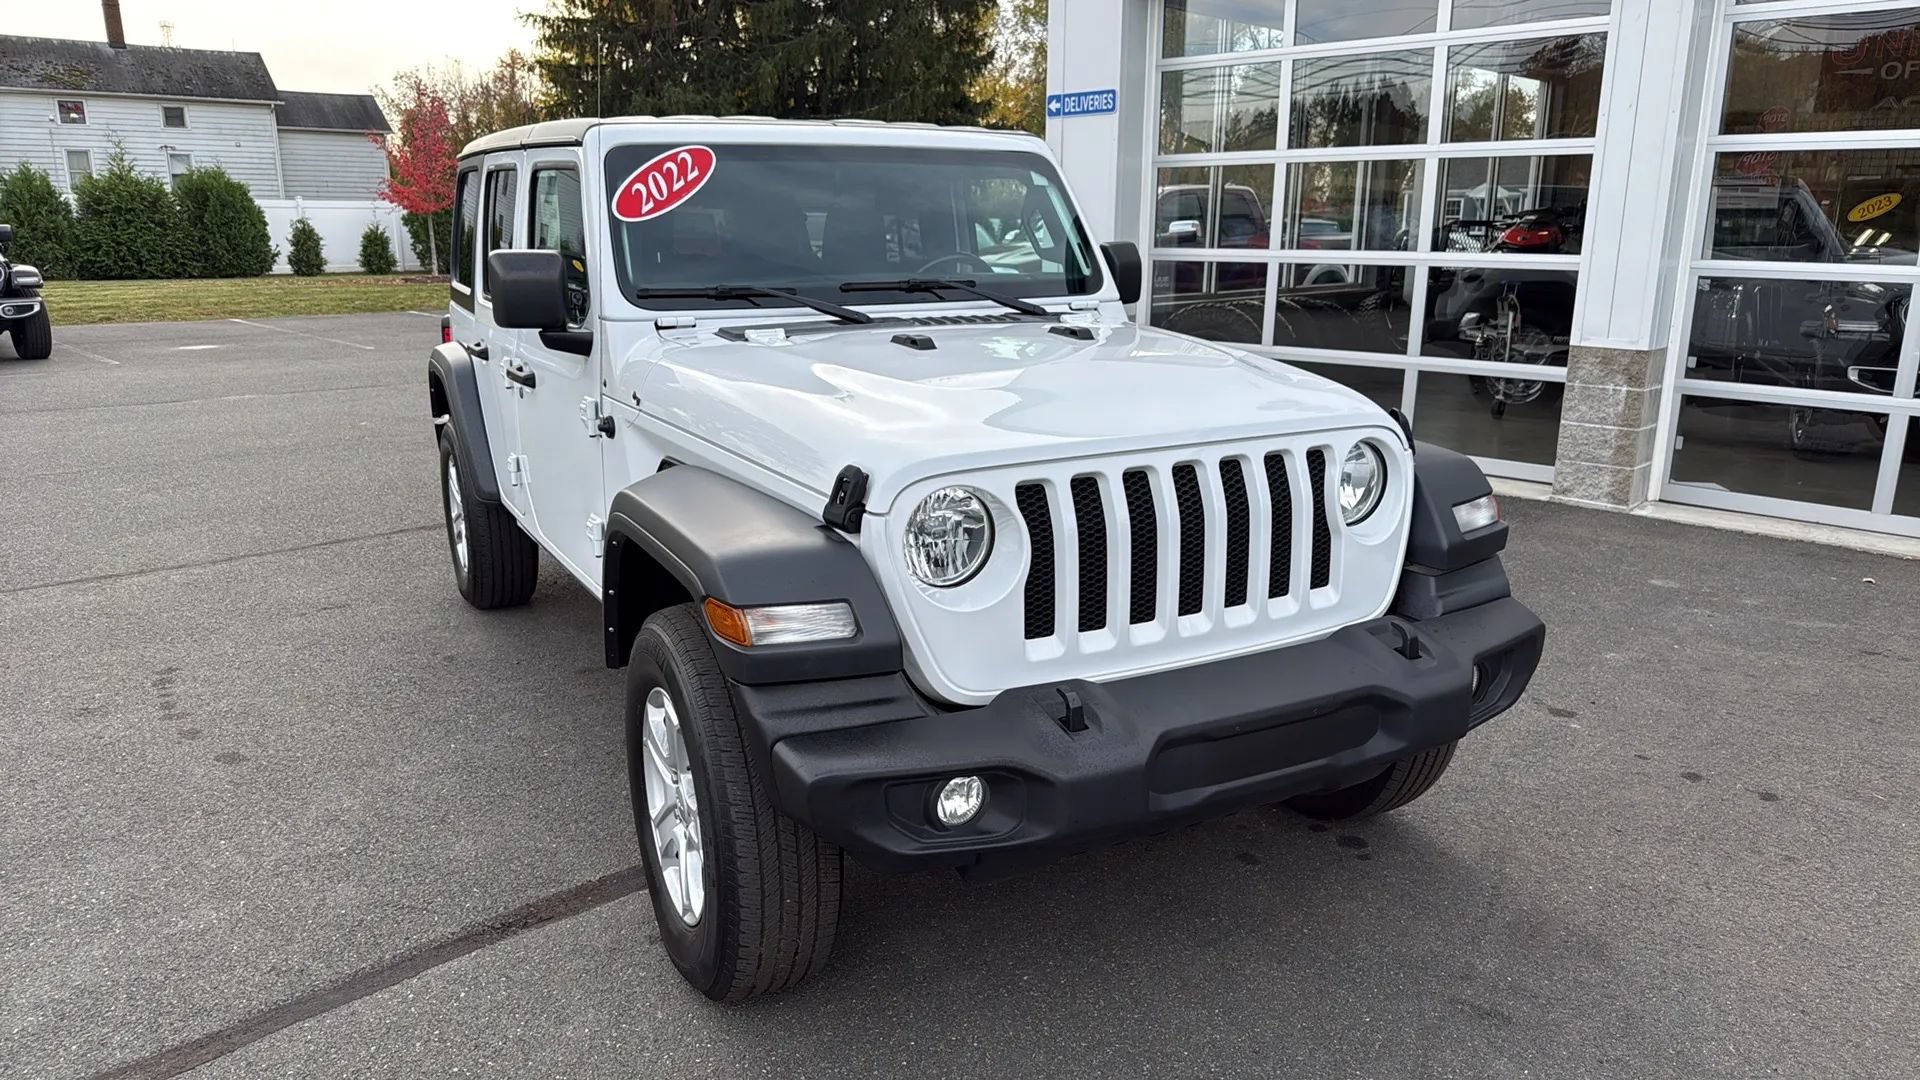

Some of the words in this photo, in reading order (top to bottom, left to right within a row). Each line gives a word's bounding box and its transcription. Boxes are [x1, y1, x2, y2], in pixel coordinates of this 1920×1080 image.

[1064, 93, 1114, 113] DELIVERIES
[631, 151, 699, 214] 2022
[1858, 196, 1892, 218] 2023
